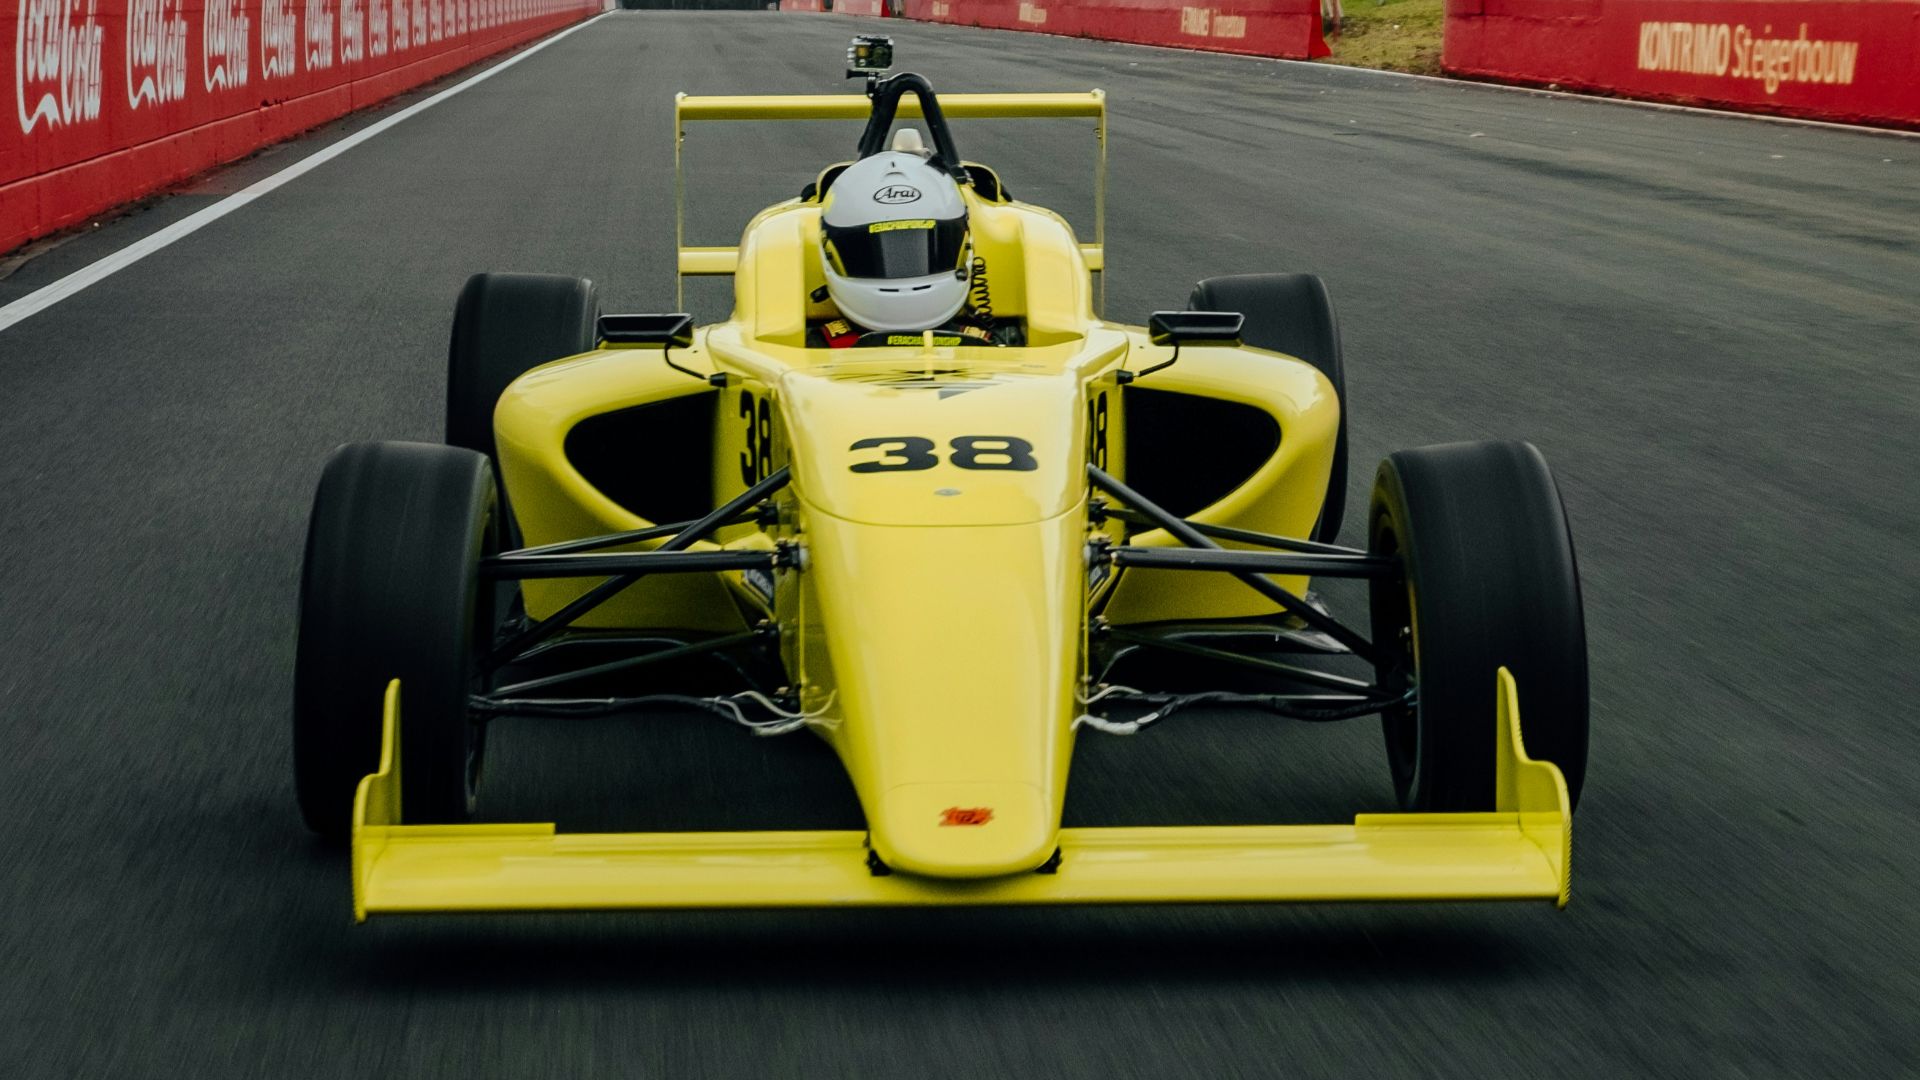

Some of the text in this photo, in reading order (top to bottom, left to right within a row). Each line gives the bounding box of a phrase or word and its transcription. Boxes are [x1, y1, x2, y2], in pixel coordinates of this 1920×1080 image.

[1638, 21, 1859, 94] KONTRIMO Steigerbouw
[876, 187, 916, 201] Arai
[740, 389, 772, 487] 38
[848, 435, 1039, 473] 38
